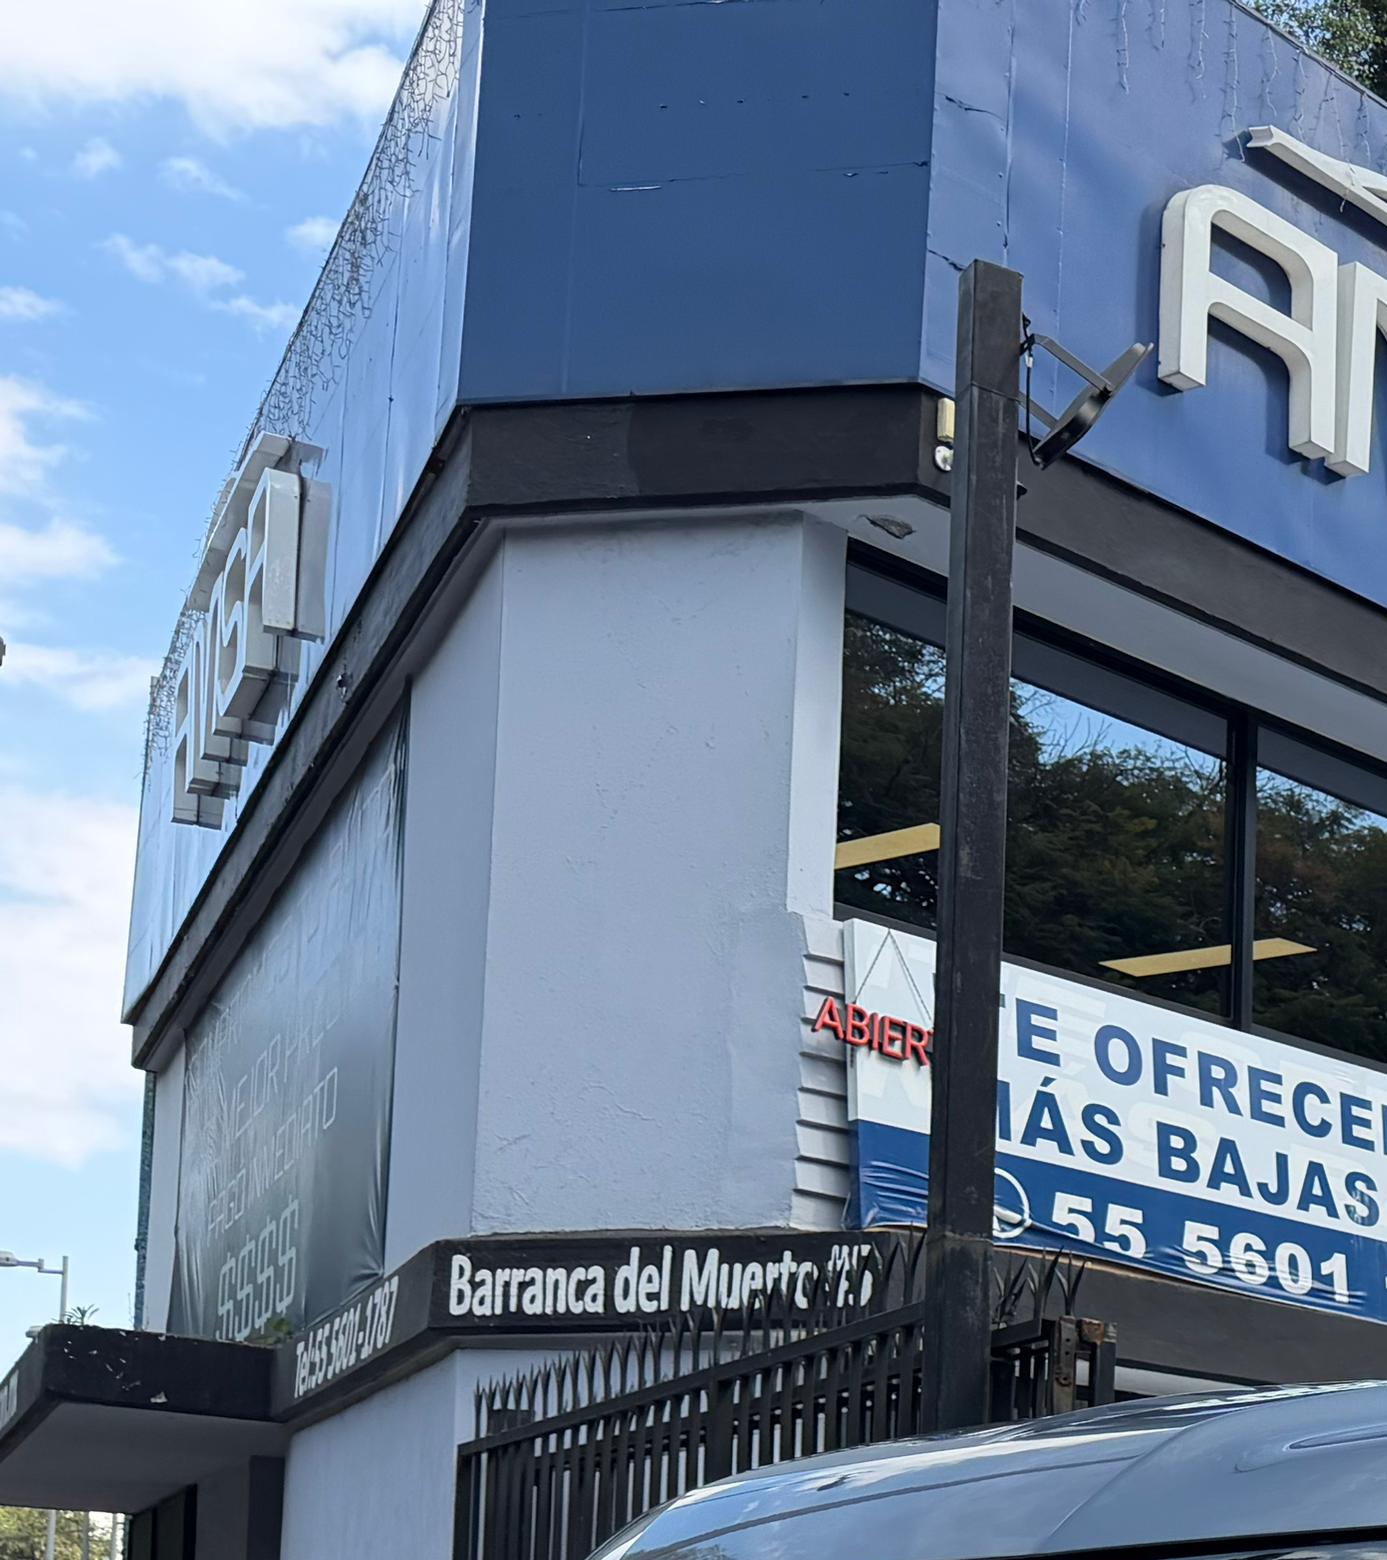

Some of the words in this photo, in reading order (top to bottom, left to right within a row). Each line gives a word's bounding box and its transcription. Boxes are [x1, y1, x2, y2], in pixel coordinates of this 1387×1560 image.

[812, 996, 934, 1067] ABIER
[1000, 993, 1061, 1067] E
[1157, 1121, 1380, 1228] BAJAS
[448, 1254, 606, 1316] Barranca
[614, 1245, 672, 1313] del
[680, 1248, 819, 1313] Muerto
[1051, 1191, 1147, 1260] 55
[1181, 1220, 1351, 1304] 5601
